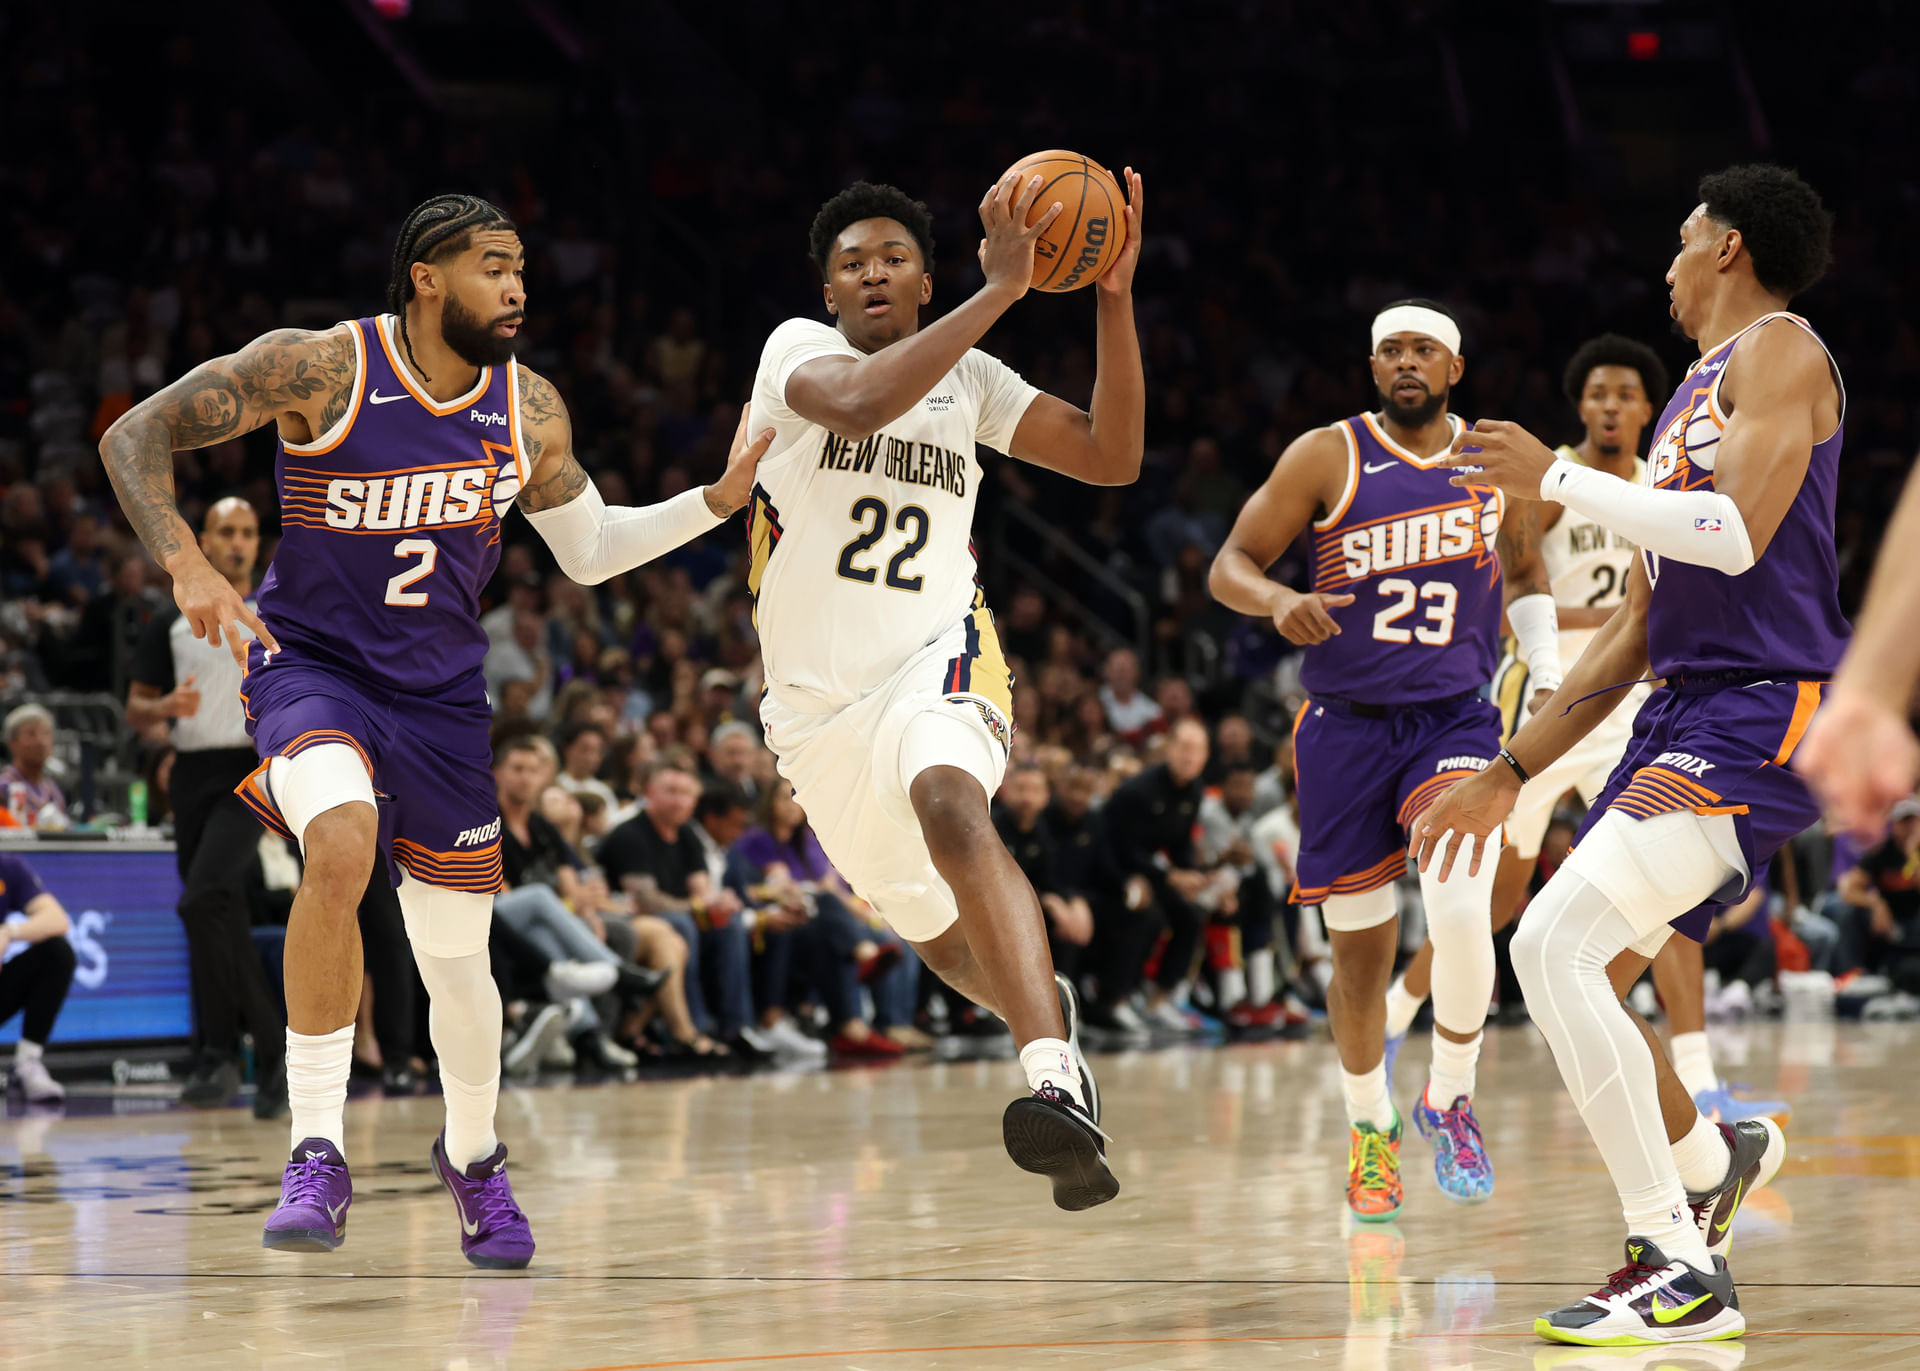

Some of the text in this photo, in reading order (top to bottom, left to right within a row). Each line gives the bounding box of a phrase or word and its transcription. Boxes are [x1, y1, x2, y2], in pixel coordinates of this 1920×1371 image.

[1051, 216, 1108, 290] Wilson
[470, 410, 507, 427] PayPal
[818, 430, 966, 498] NEW ORLEANS
[325, 468, 486, 530] SUNS
[384, 538, 438, 607] 2
[836, 495, 931, 594] 22
[1342, 506, 1475, 579] SUNS
[1372, 578, 1458, 646] 23
